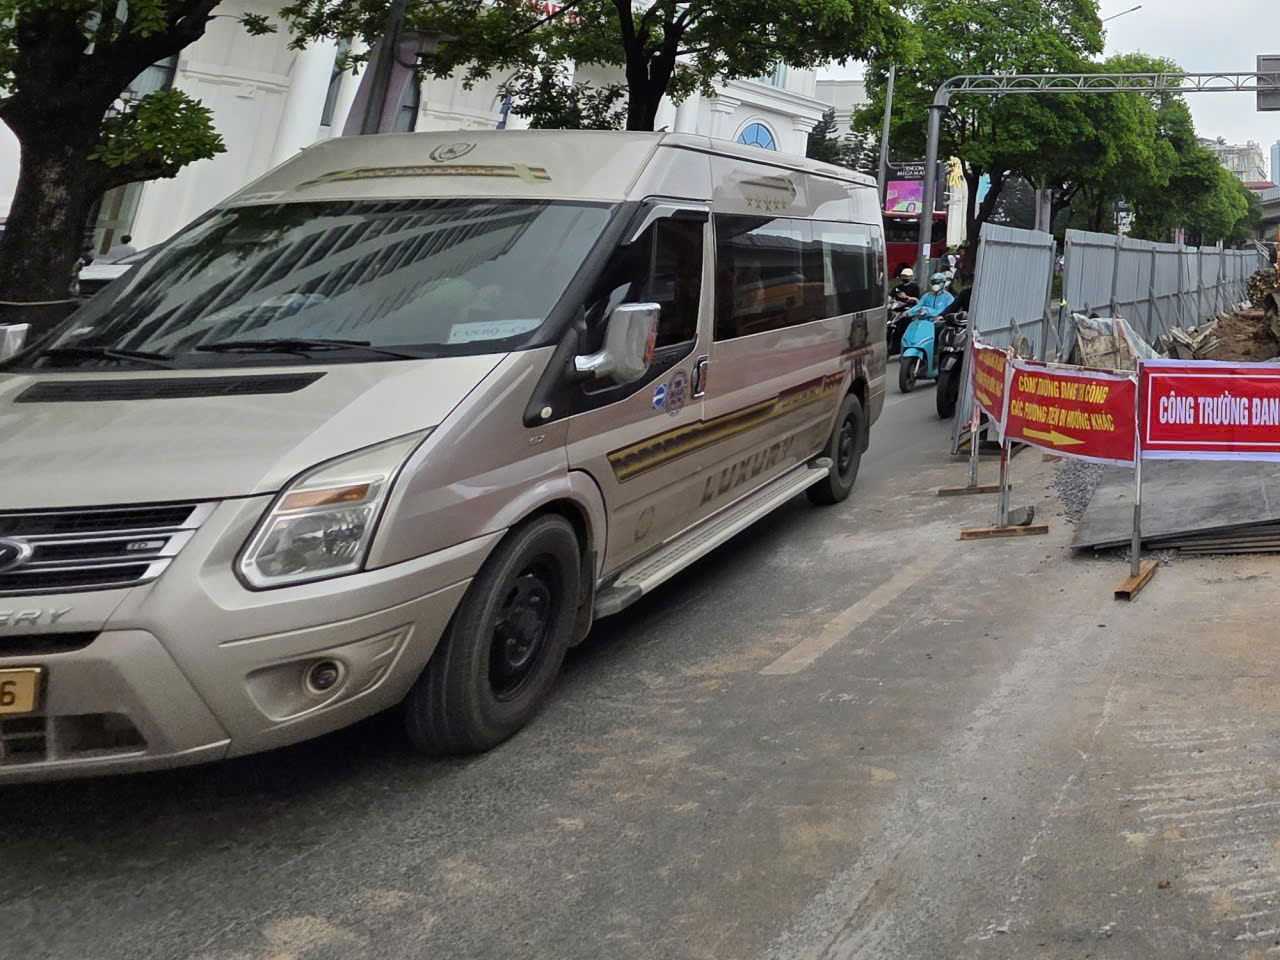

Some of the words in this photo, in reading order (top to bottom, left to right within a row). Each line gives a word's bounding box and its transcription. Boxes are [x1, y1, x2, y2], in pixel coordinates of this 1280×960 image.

[1085, 381, 1109, 404] CÔNG
[1091, 410, 1115, 432] KHÁC
[1159, 390, 1195, 424] CÔNG
[1198, 390, 1248, 425] TRƯỜNG
[699, 435, 794, 506] LUXURY
